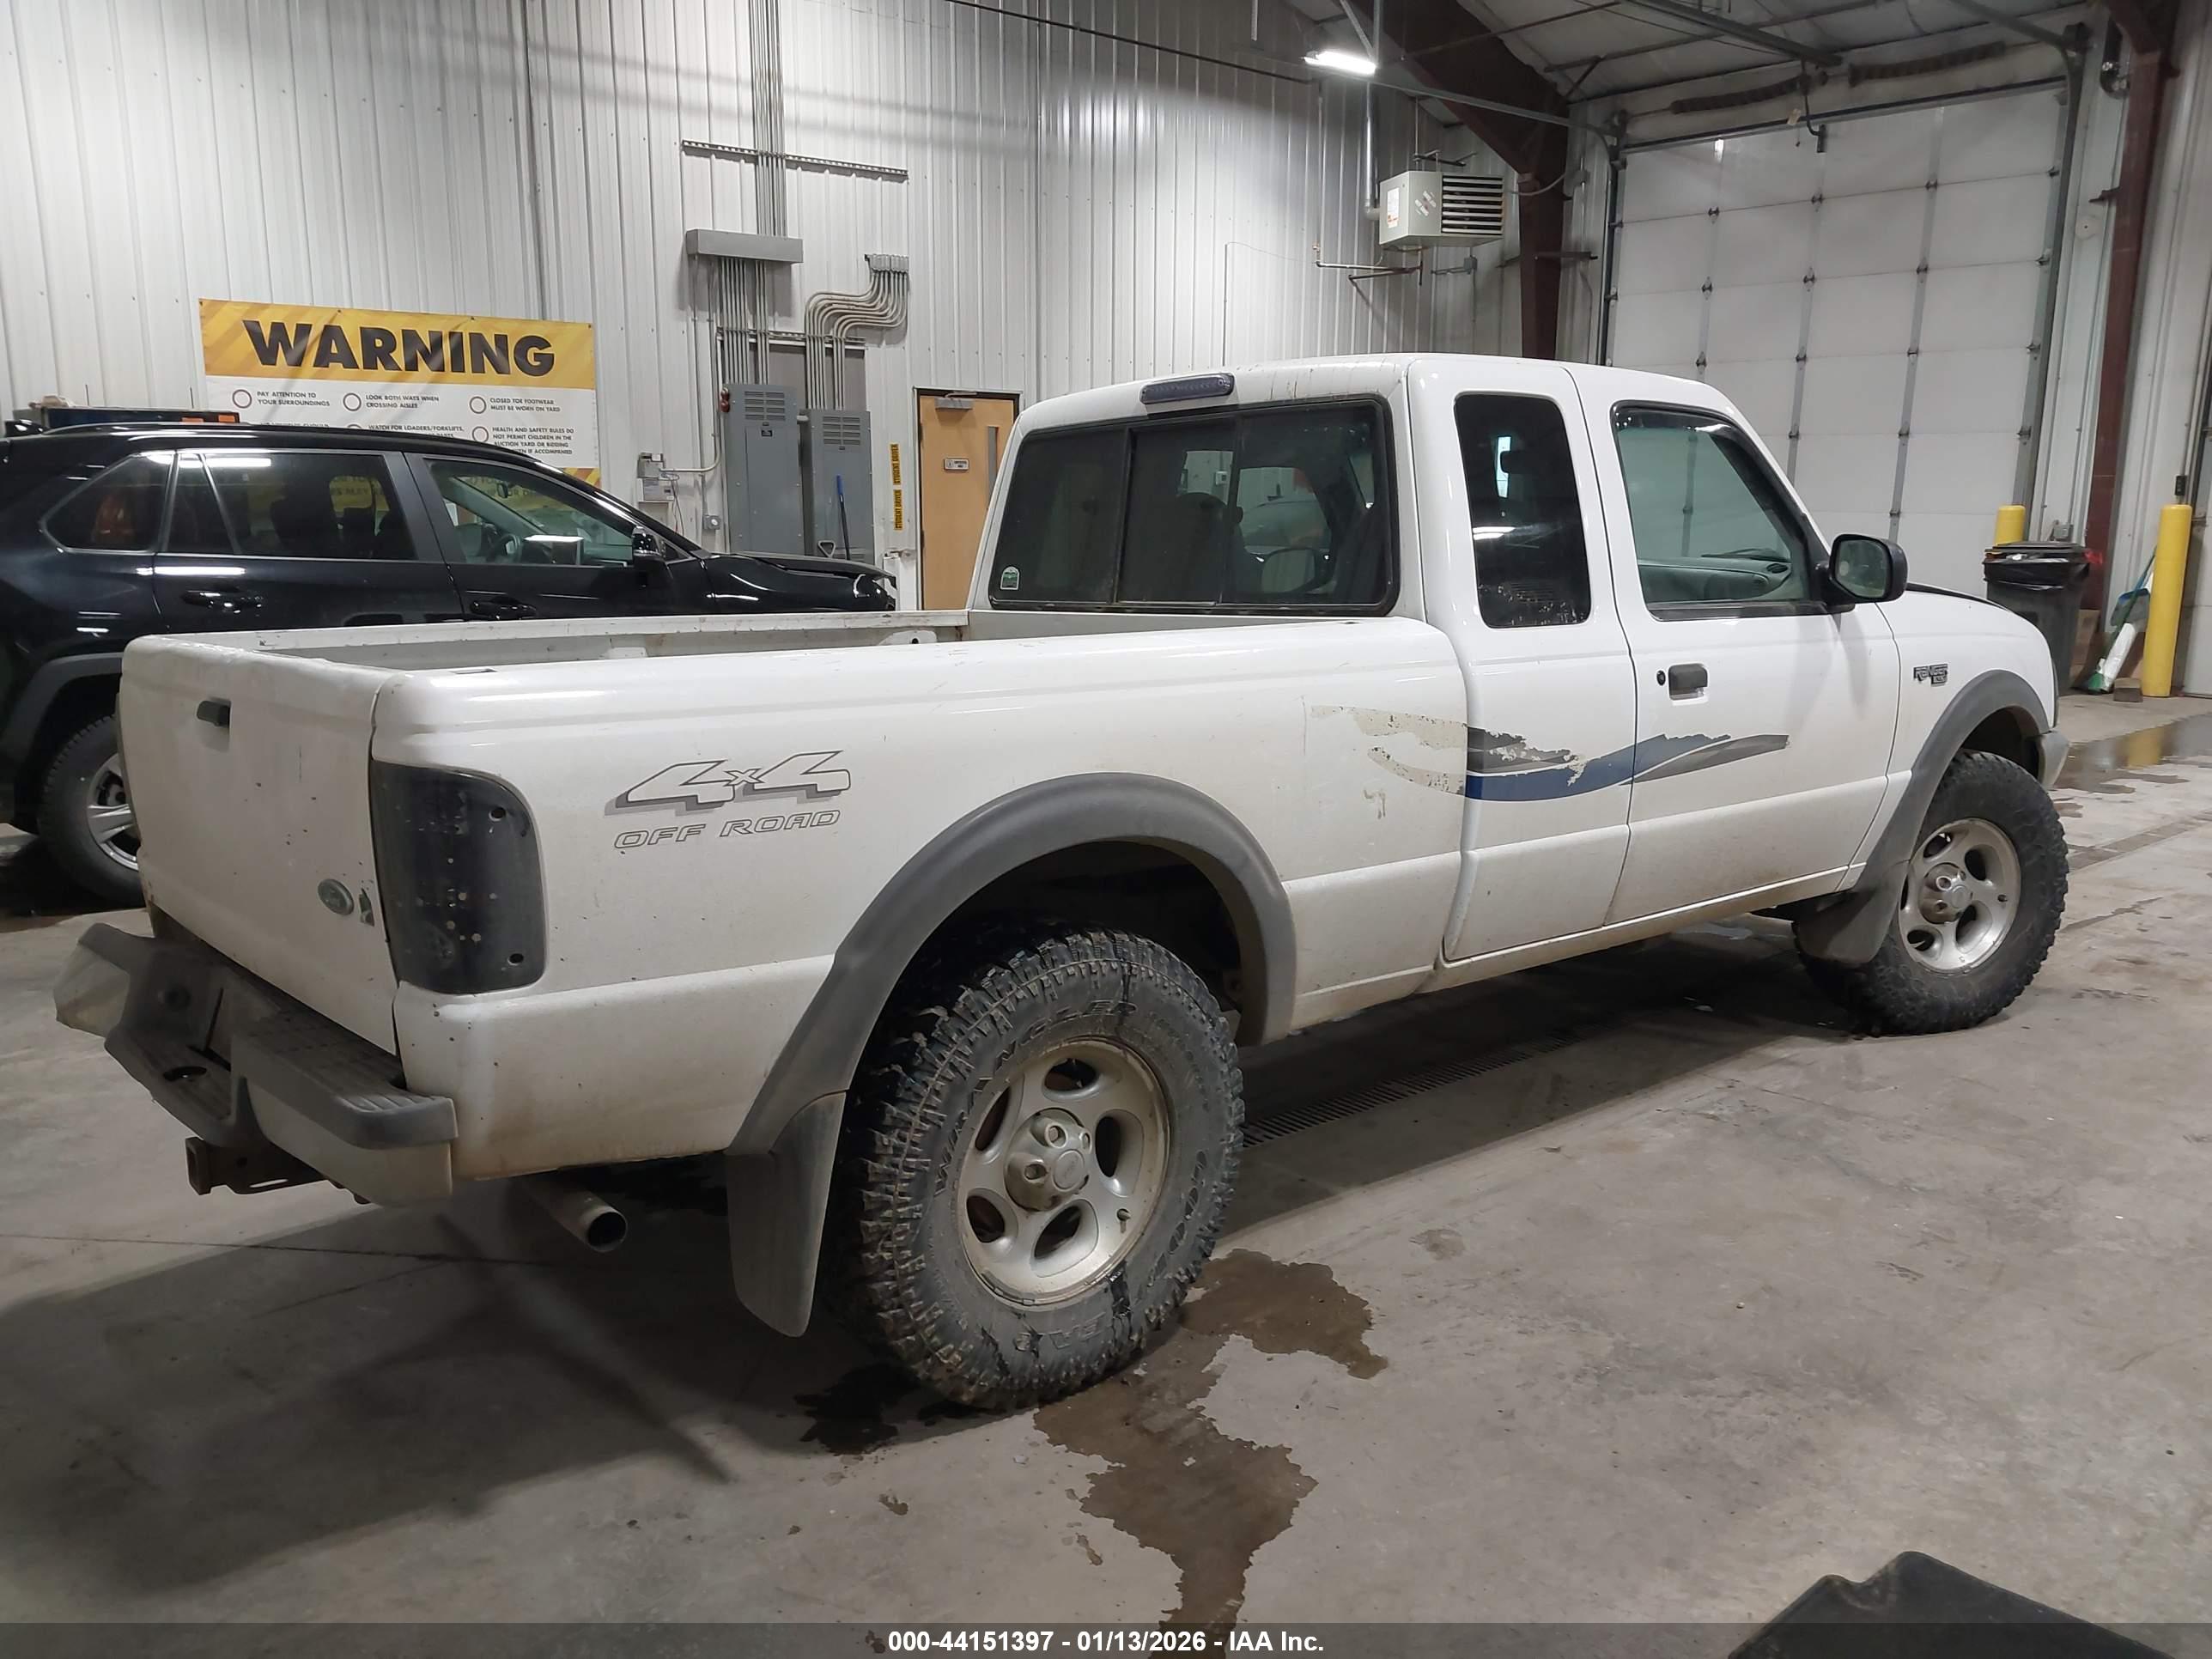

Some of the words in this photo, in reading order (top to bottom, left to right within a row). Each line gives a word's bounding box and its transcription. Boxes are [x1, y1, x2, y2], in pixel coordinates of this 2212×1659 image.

[243, 319, 555, 378] WARNING
[890, 444, 899, 461] DRIVER
[892, 463, 901, 484] STUDENT
[895, 507, 903, 530] STUDENT
[605, 750, 851, 817] 4x4
[614, 823, 706, 848] OFF
[720, 810, 841, 837] ROAD
